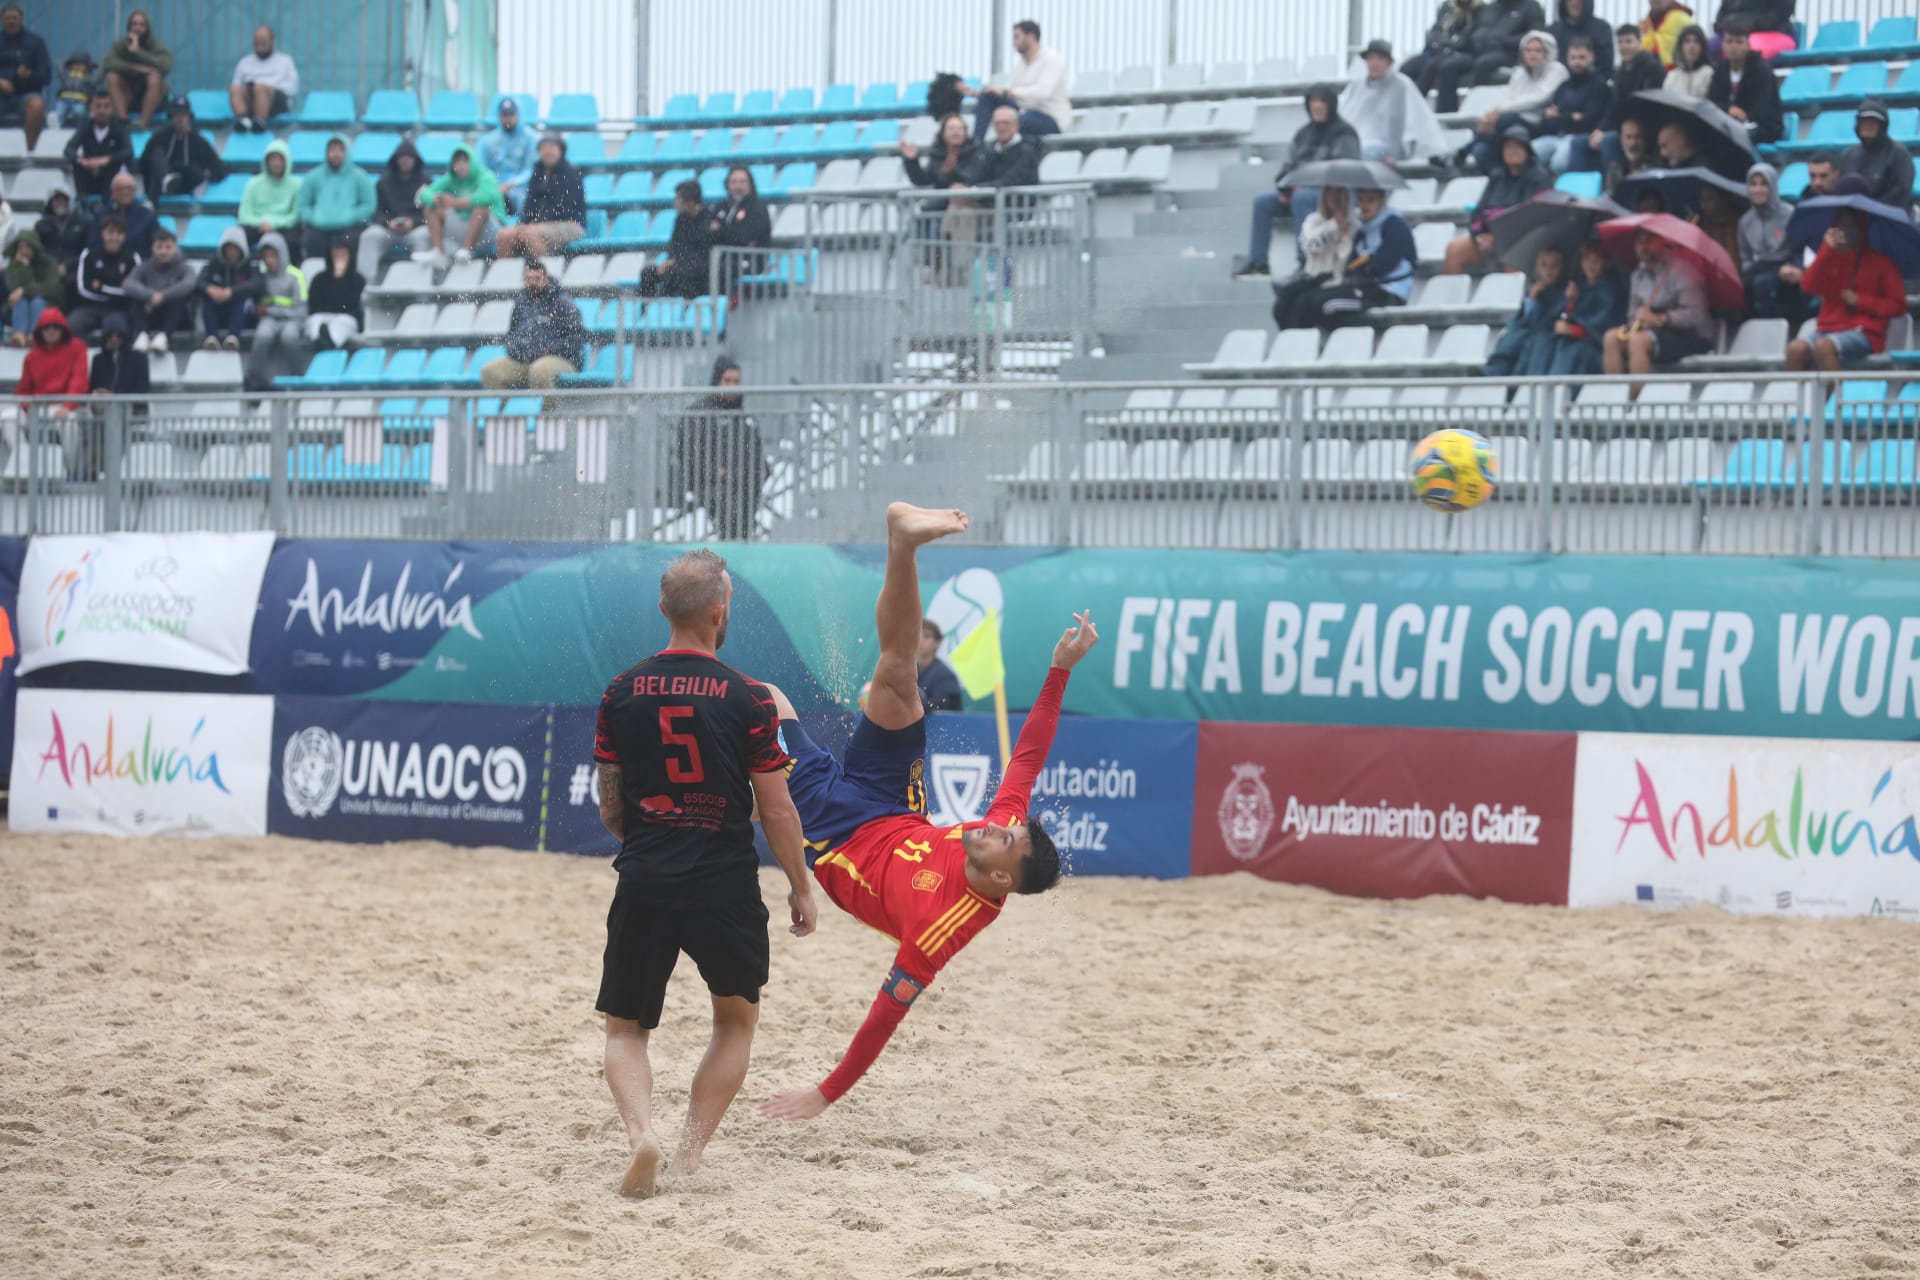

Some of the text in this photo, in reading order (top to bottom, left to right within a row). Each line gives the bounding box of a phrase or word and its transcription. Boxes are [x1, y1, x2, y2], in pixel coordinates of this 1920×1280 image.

[285, 557, 484, 640] Andalucía
[633, 675, 729, 699] BELGIUM
[1113, 596, 1243, 693] FIFA
[1261, 600, 1471, 700] BEACH
[1482, 604, 1755, 711] SOCCER
[37, 707, 232, 797] Andalucía
[342, 739, 482, 801] UNAOC
[658, 705, 705, 783] 5
[340, 799, 524, 824] United Nations Alliance of Civilizations
[1281, 795, 1541, 846] Ayuntamiento de Cádiz
[1612, 756, 1920, 863] Andalucía
[893, 839, 932, 863] 11
